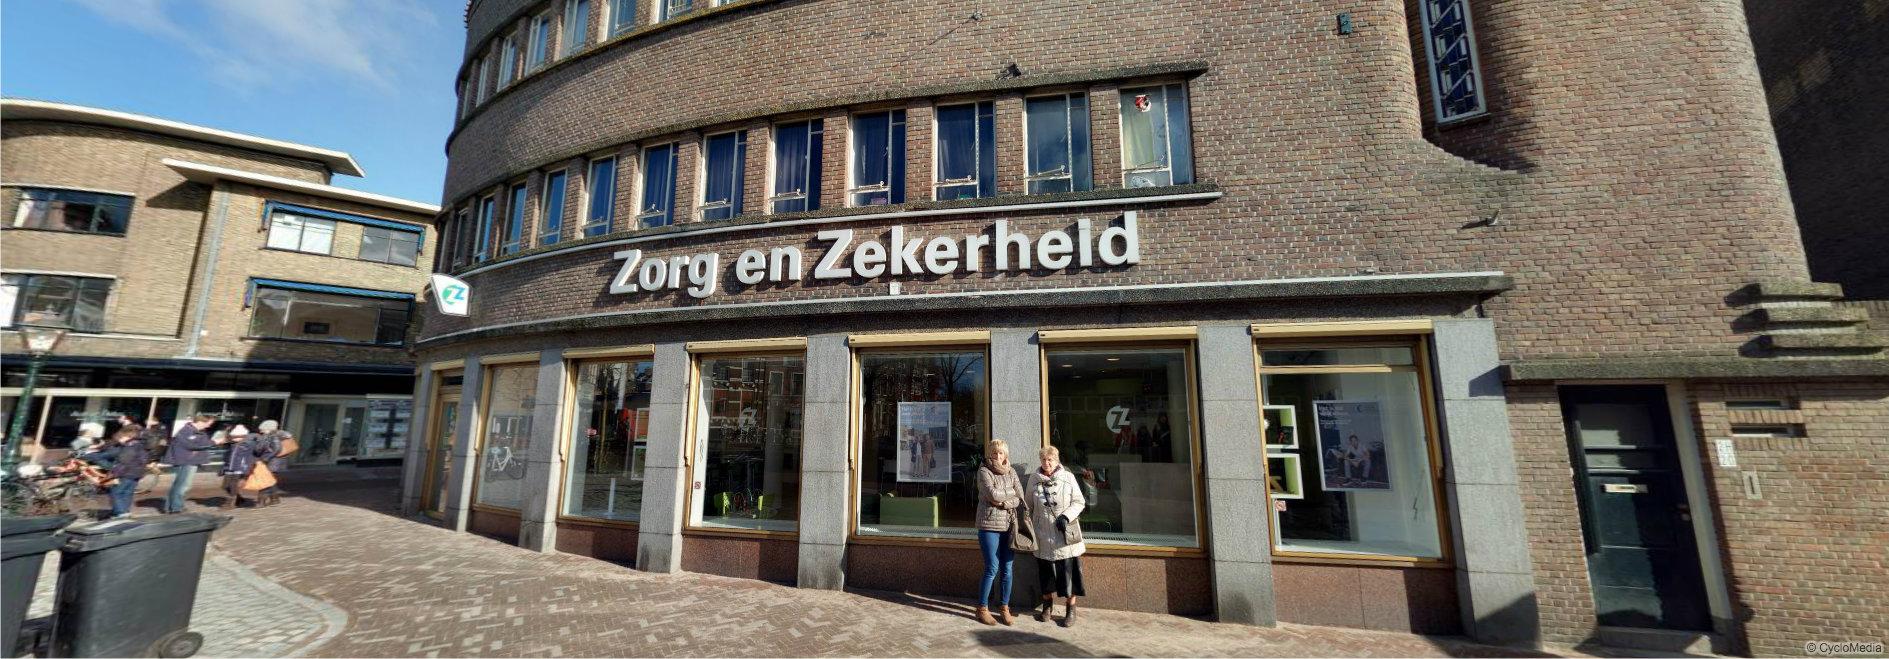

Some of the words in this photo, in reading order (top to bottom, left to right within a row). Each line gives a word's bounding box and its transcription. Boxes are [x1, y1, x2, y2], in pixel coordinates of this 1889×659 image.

[609, 249, 719, 299] Zorg
[735, 245, 802, 284] en
[814, 211, 1141, 280] Zekerheid
